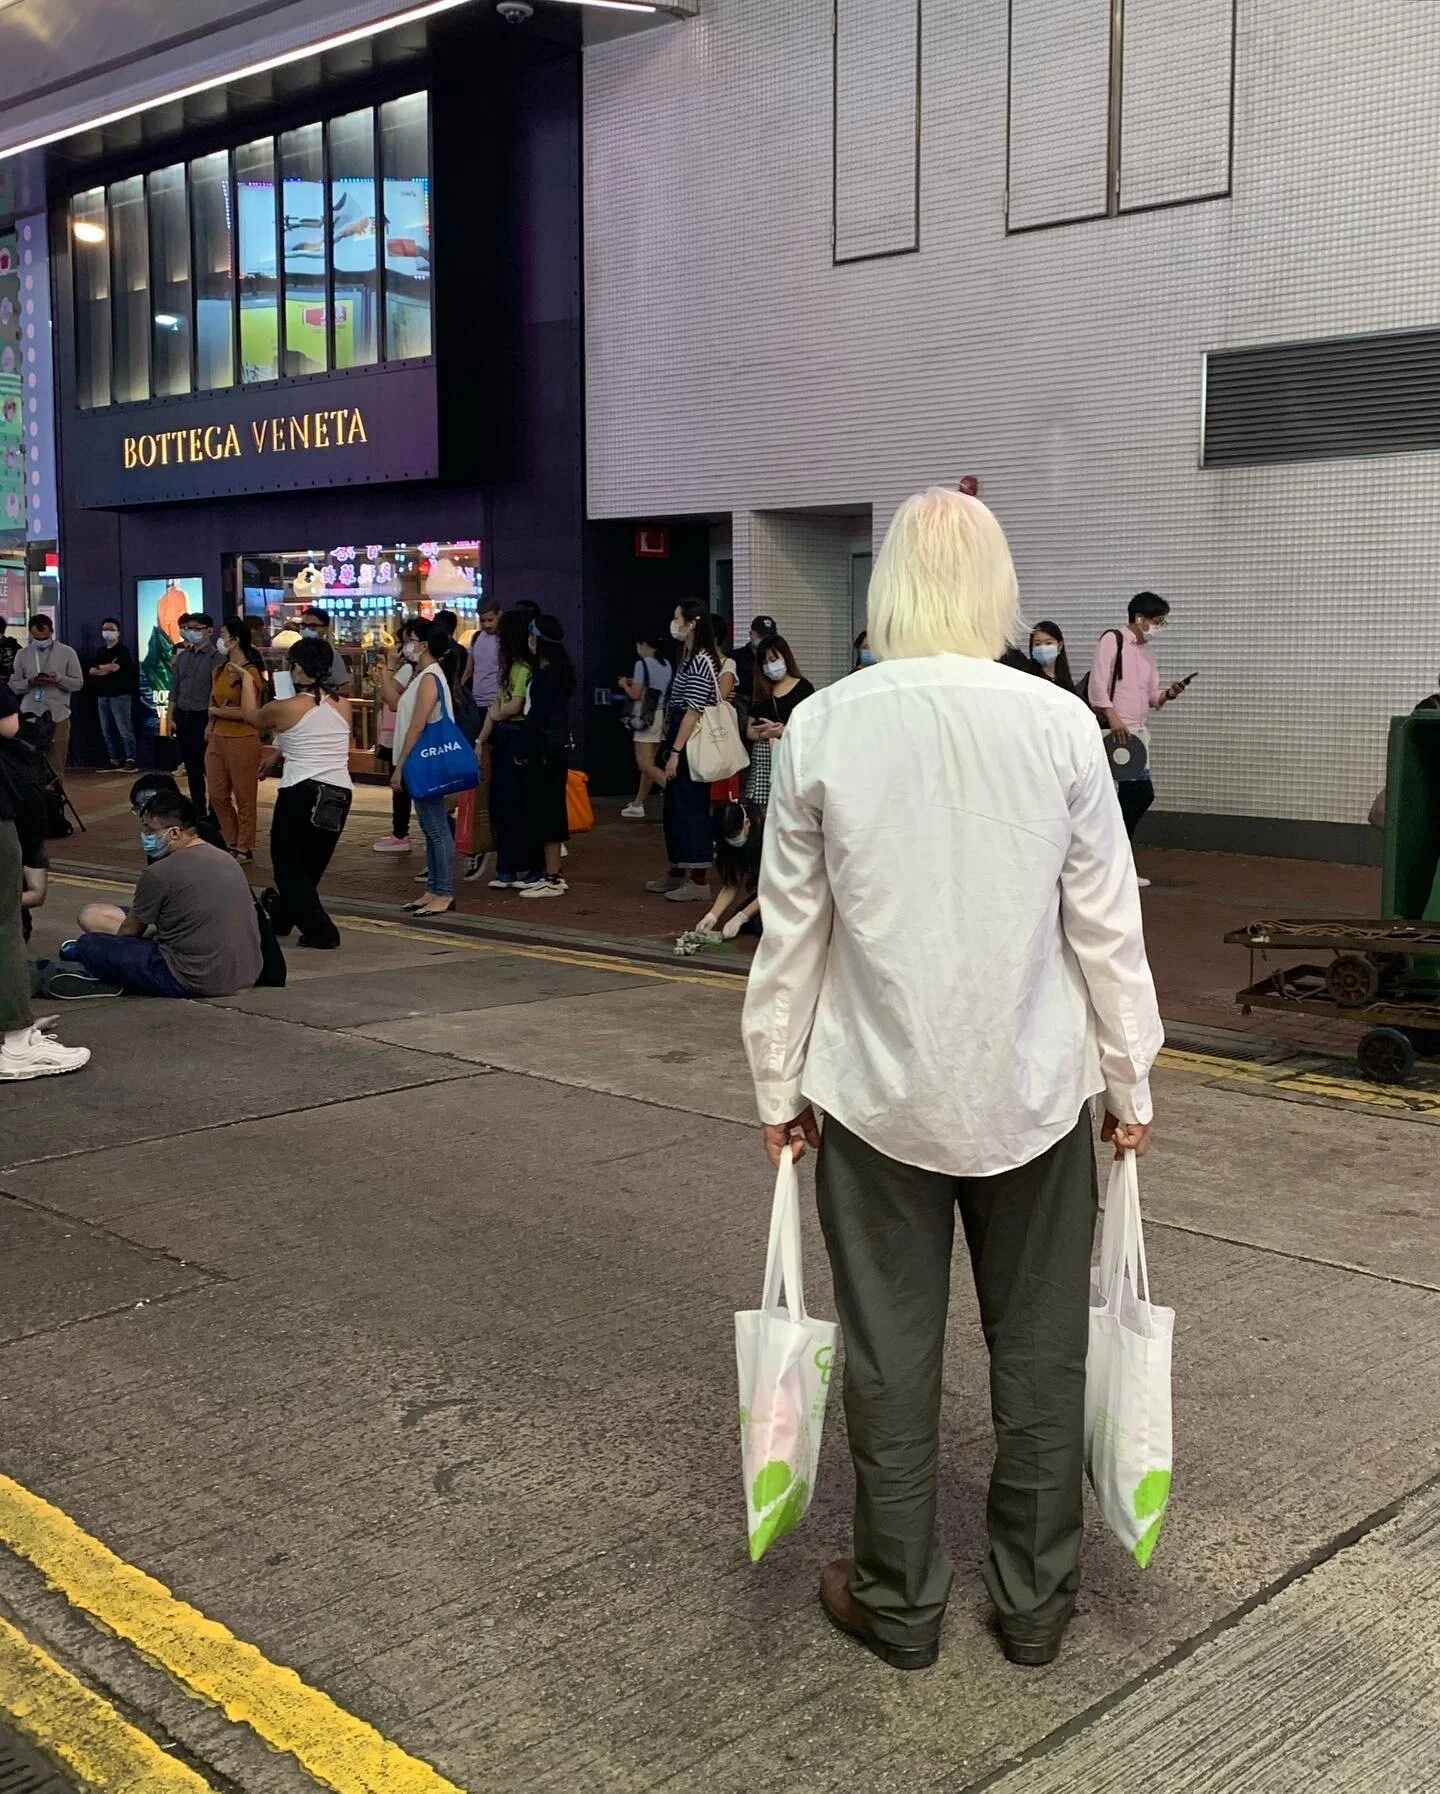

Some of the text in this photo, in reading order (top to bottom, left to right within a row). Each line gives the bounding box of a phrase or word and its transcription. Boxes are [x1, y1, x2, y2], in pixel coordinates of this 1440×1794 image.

[123, 407, 368, 469] BOTTEGA VENETA
[420, 741, 463, 758] GRANA
